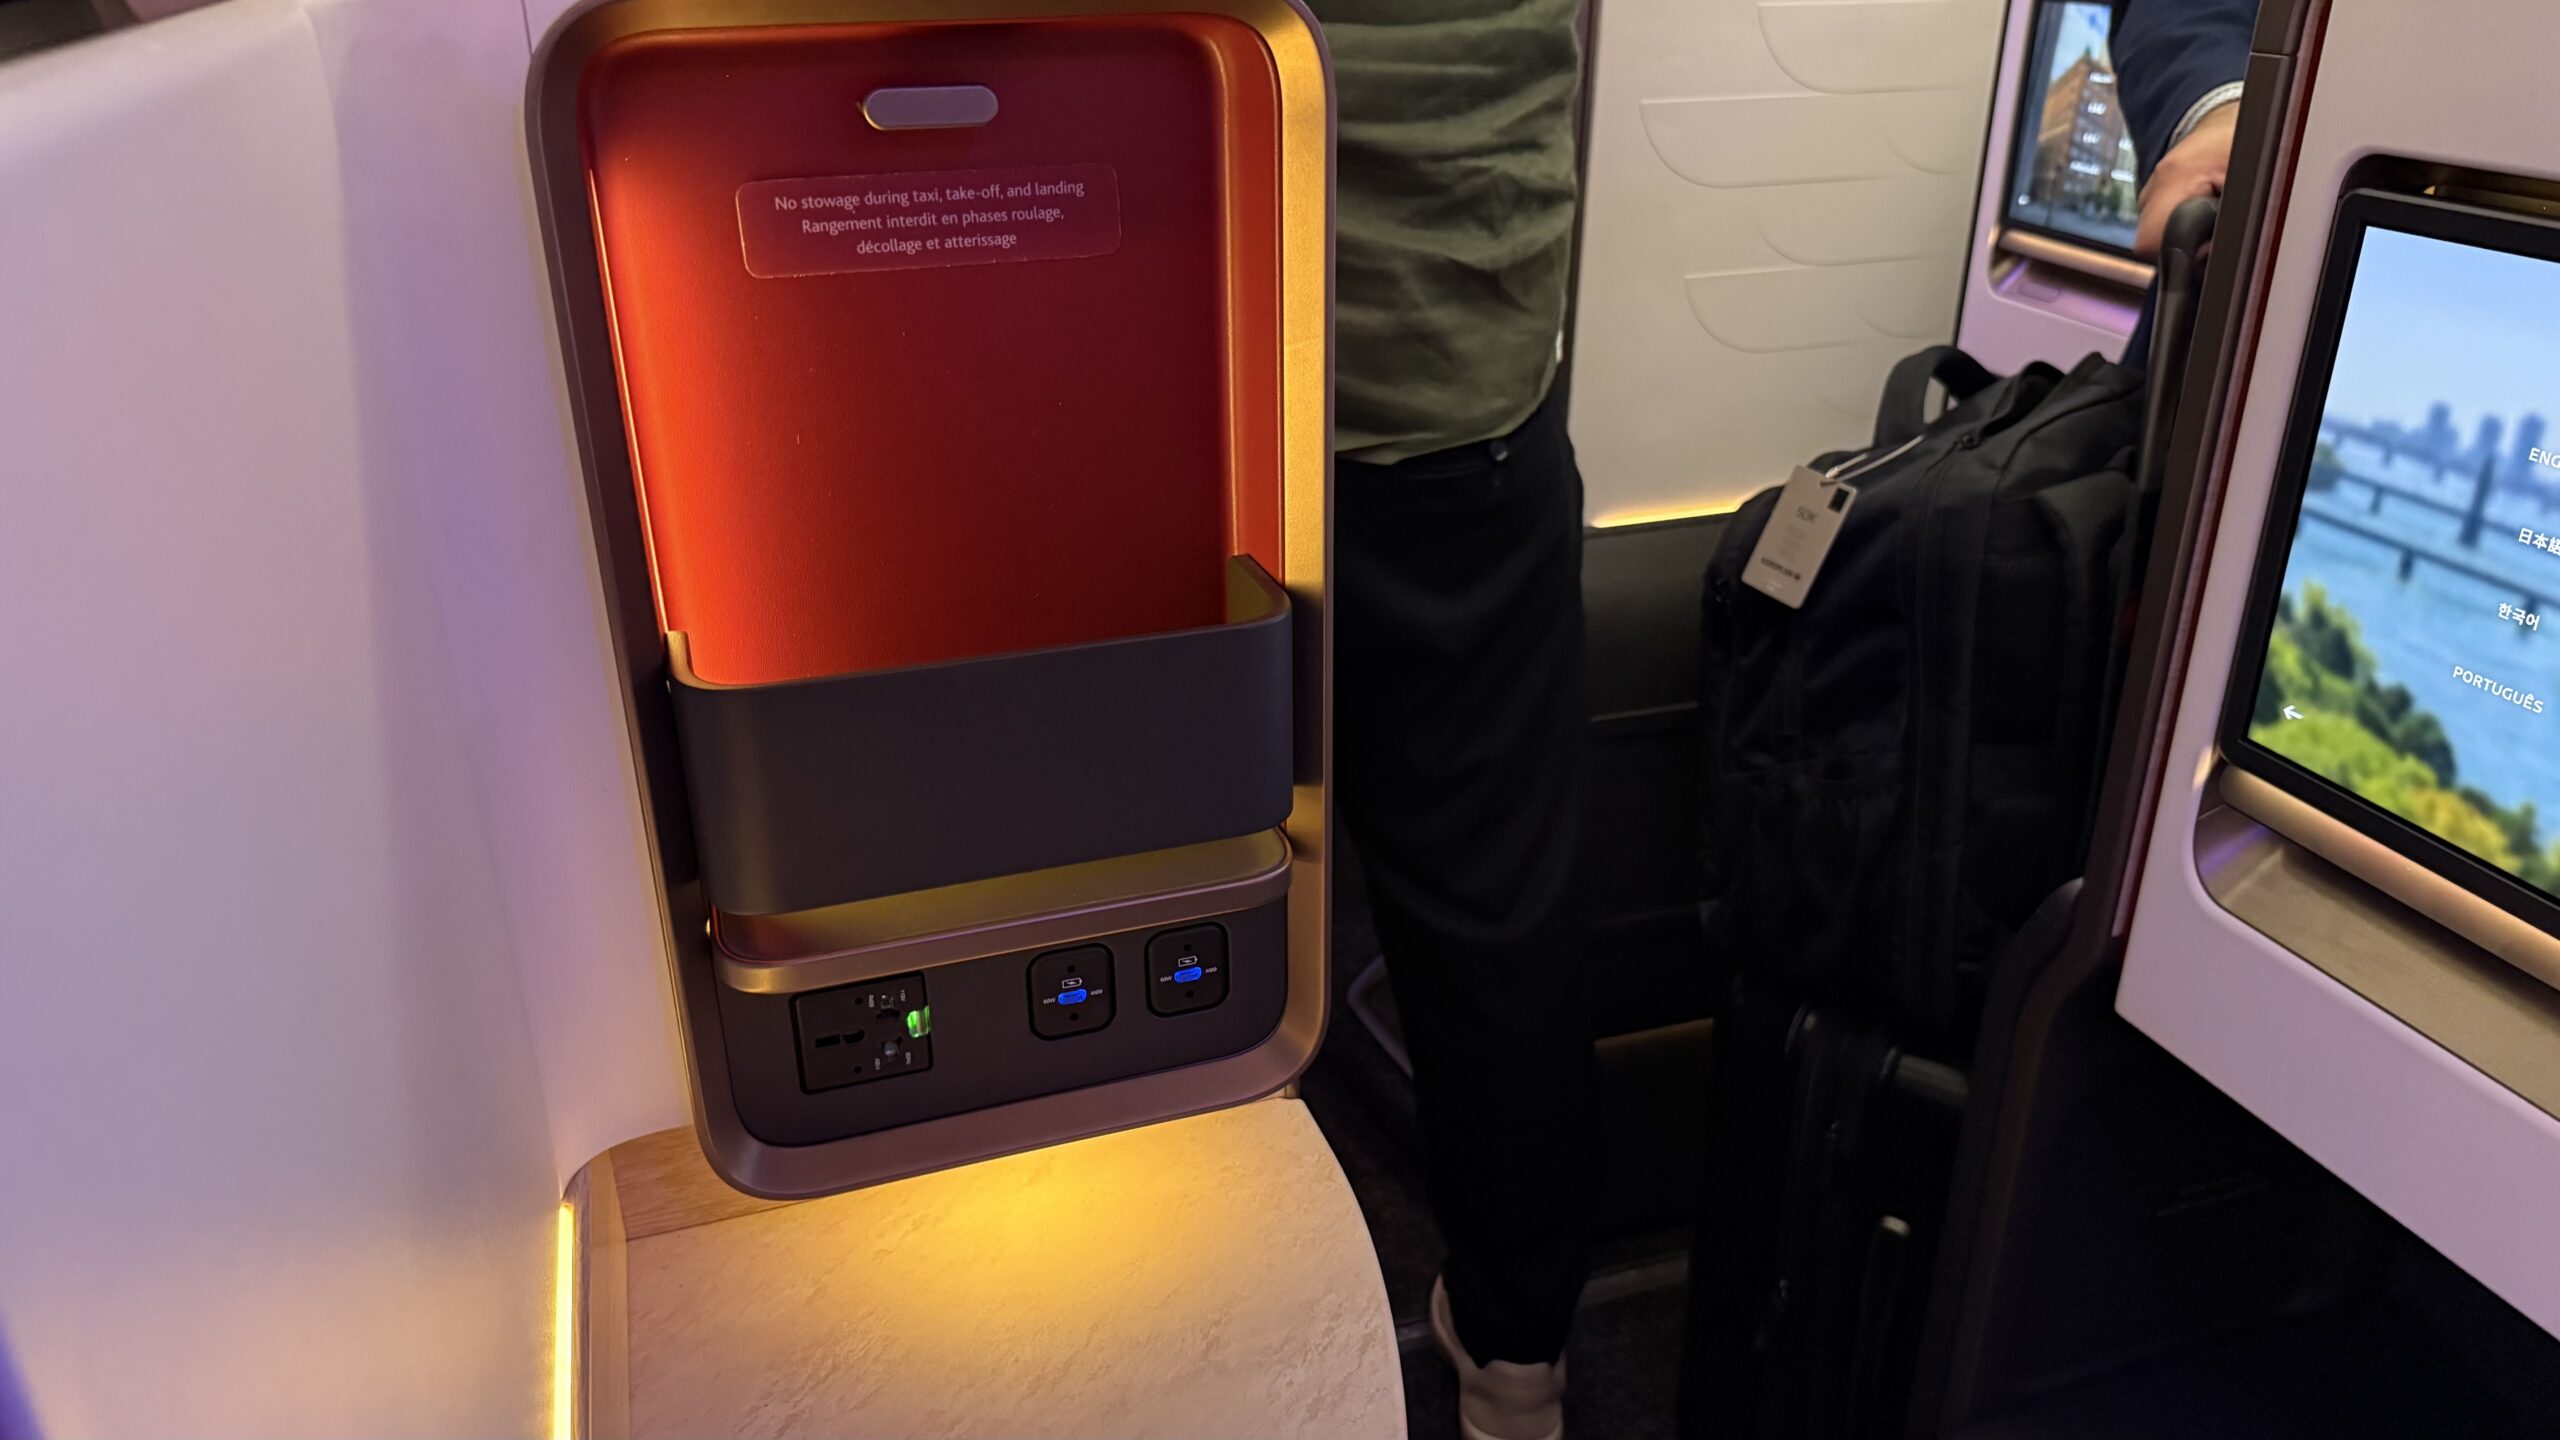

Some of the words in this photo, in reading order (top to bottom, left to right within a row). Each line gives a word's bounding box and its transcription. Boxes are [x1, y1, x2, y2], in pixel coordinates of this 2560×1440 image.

[774, 196, 798, 211] No
[801, 193, 860, 211] stowage
[864, 190, 910, 207] during
[913, 188, 943, 203] taxi,
[946, 185, 1003, 201] take-off,
[1007, 182, 1032, 197] and
[1035, 180, 1085, 197] landing
[802, 216, 883, 236] Rangement
[886, 211, 938, 228] interdit
[941, 213, 959, 225] en
[962, 209, 1008, 227] phases
[1011, 206, 1064, 222] roulage,
[856, 236, 923, 255] décollage
[926, 237, 941, 250] et
[944, 232, 1018, 250] atterissage
[2518, 527, 2560, 557] 日本語
[2498, 602, 2540, 631] 한국어
[2453, 665, 2545, 714] PORTUGUÊS
